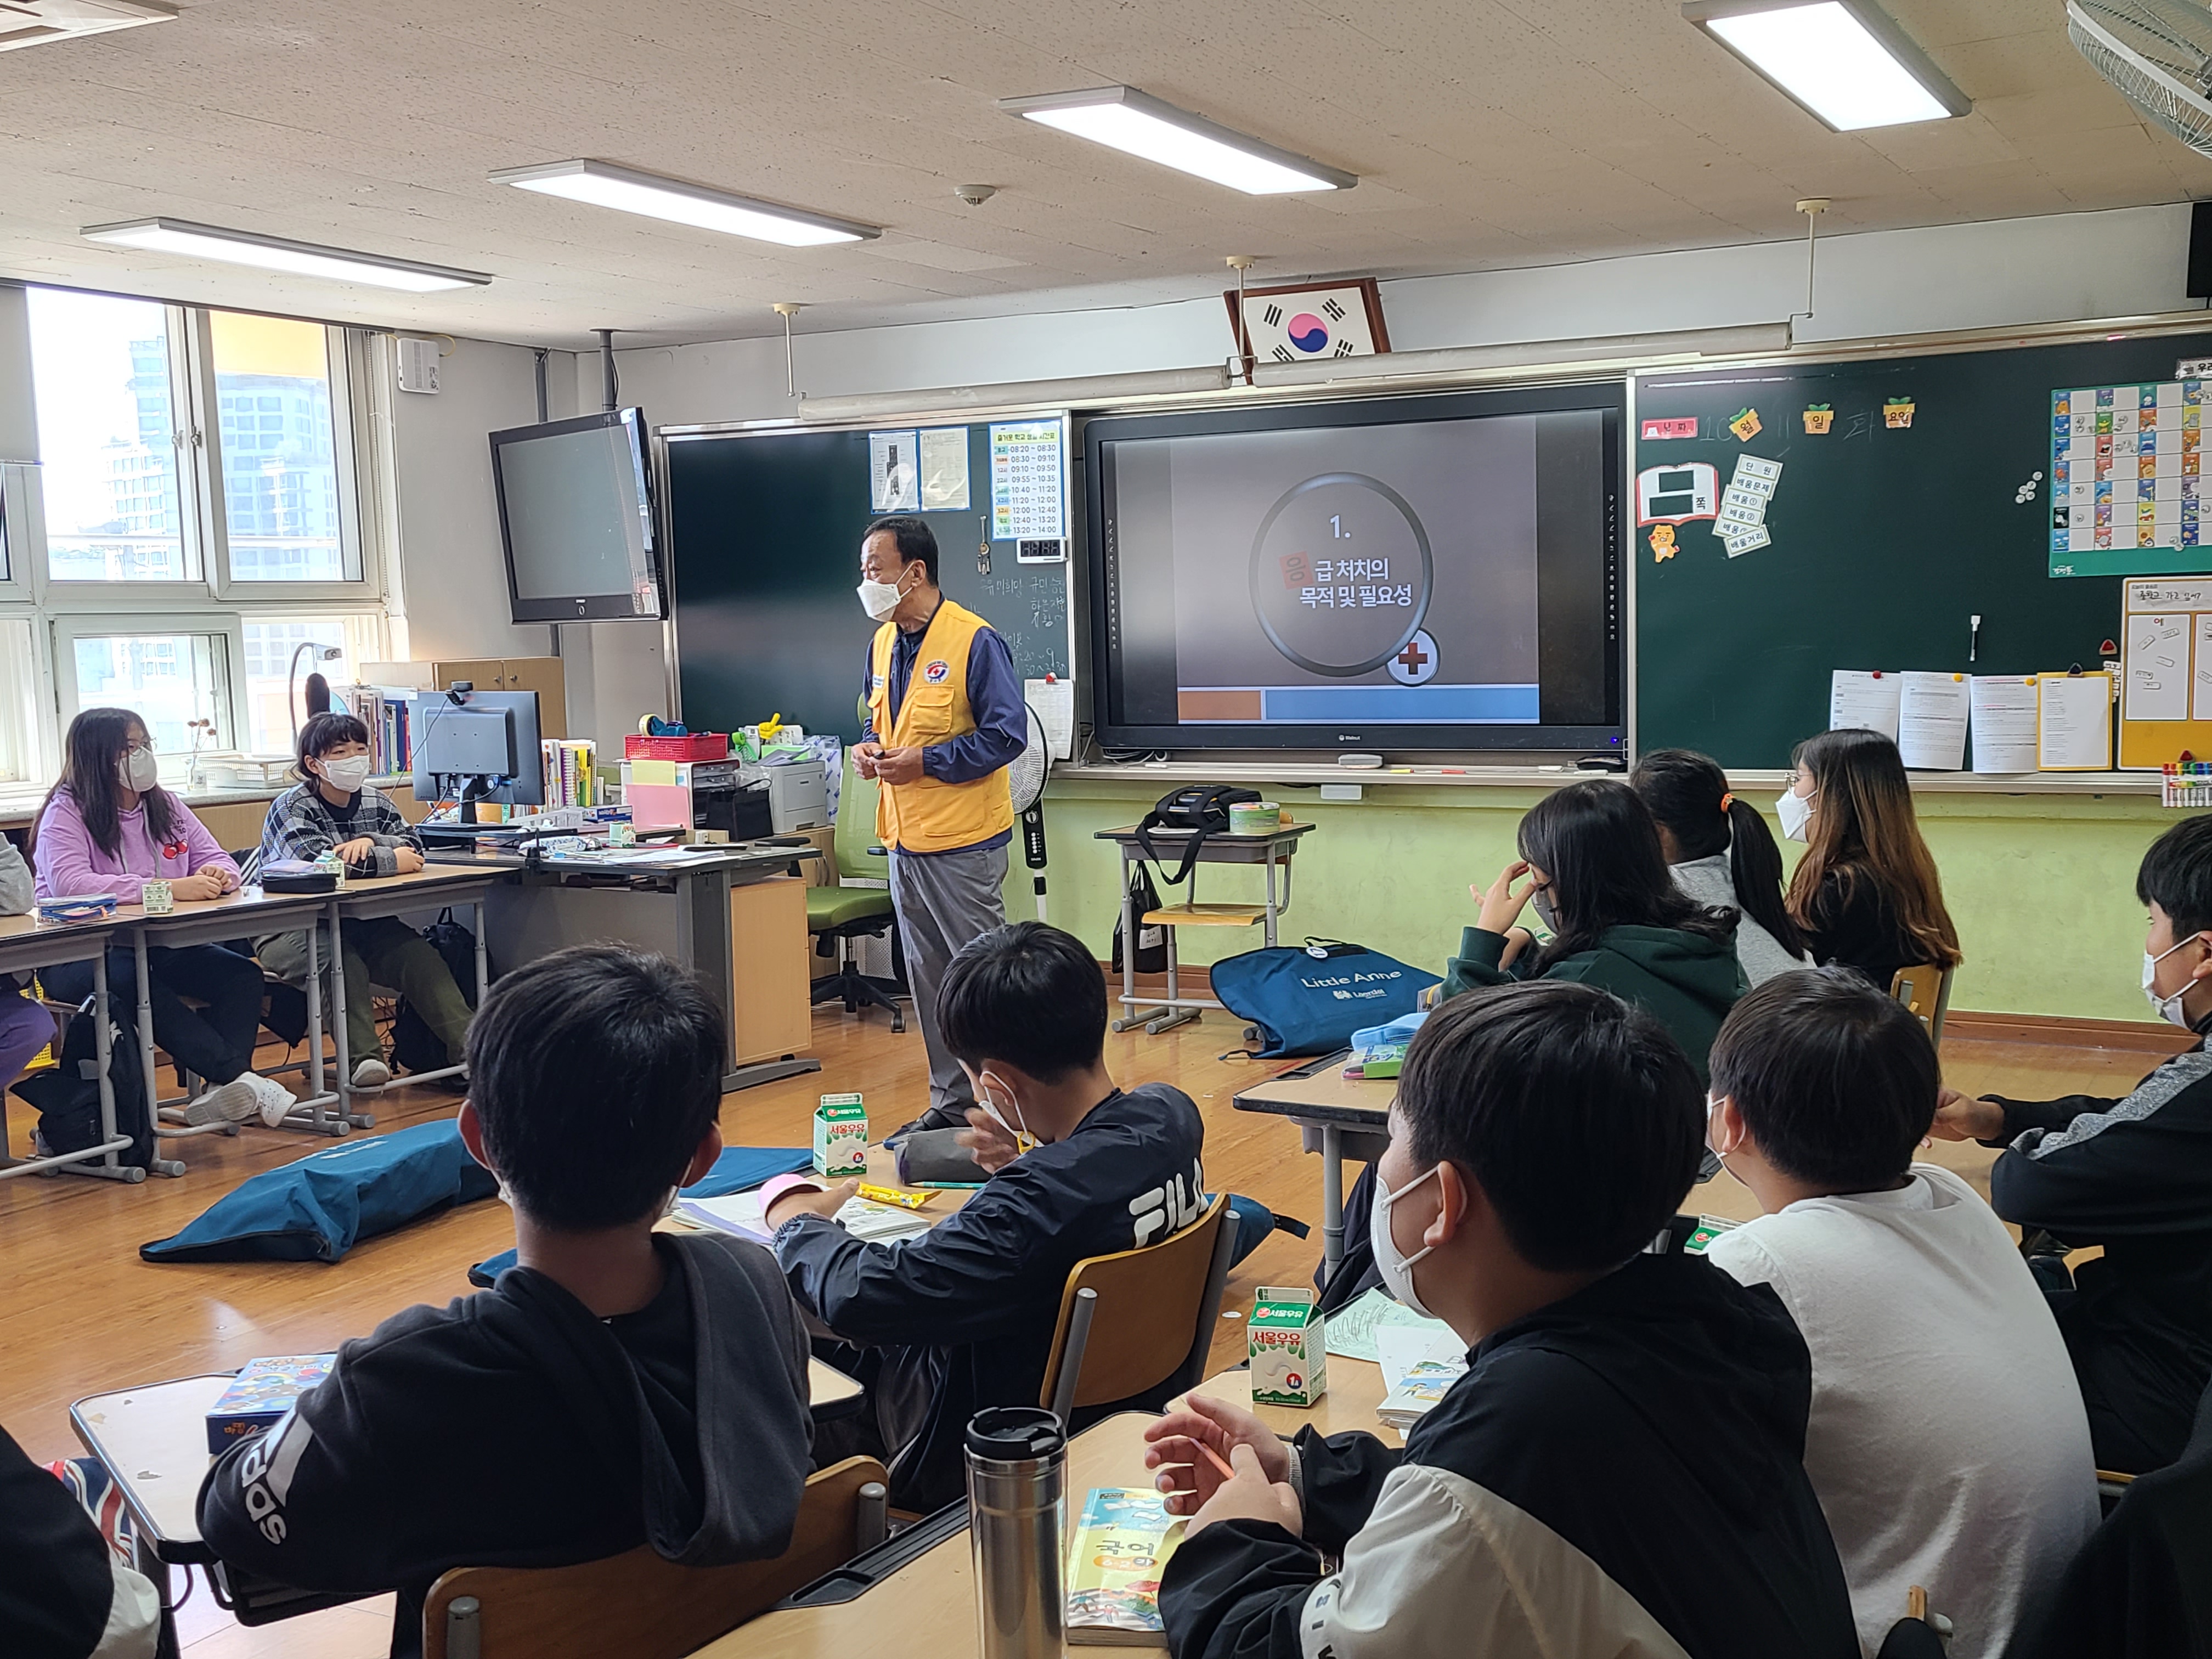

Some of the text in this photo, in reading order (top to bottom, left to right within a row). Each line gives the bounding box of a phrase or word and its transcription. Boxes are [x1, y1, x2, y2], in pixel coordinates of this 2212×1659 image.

[1740, 420, 1754, 434] 월
[1813, 415, 1824, 429] 일
[1695, 496, 1707, 510] 쪽
[1330, 515, 1351, 538] 1.
[1336, 558, 1389, 581] 처치의
[1300, 584, 1413, 608] 목적 및 필요성
[1300, 970, 1402, 989] Little Anne
[1129, 1157, 1209, 1250] FILA
[1252, 1331, 1301, 1346] 서울우유
[1096, 1539, 1154, 1556] 국어
